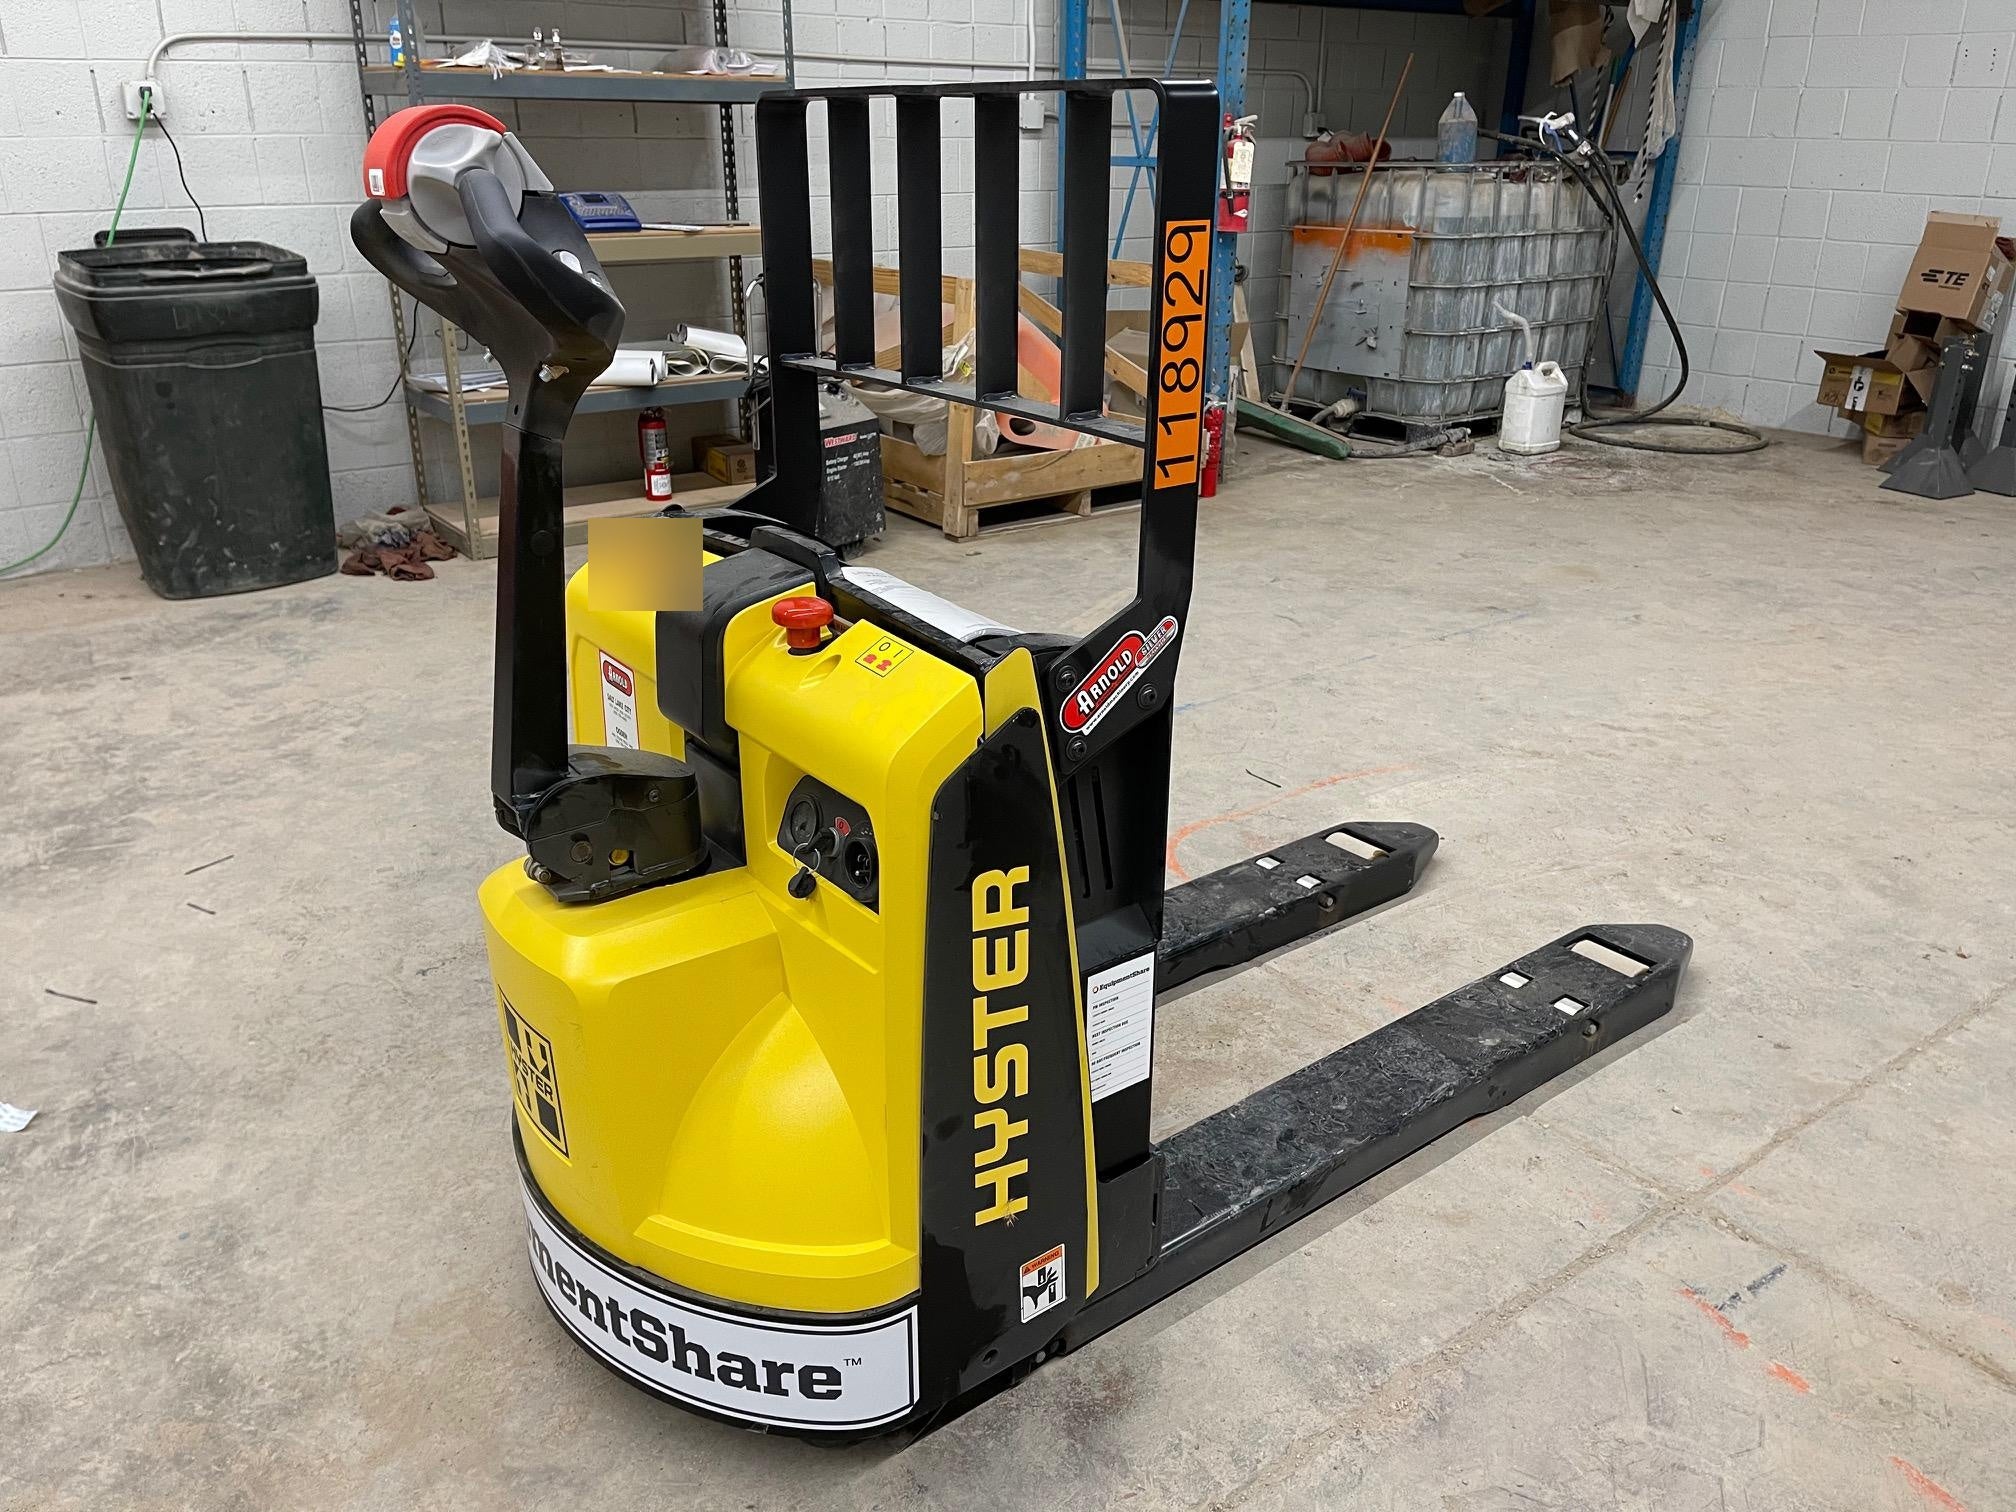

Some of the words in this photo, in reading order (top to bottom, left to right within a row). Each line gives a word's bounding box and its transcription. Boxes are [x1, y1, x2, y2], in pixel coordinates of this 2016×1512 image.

[1157, 223, 1207, 479] 118929
[1077, 650, 1133, 715] ARNOLD
[1099, 967, 1150, 991] EquipmentShare
[511, 1045, 554, 1101] HYSTER
[972, 865, 1029, 1226] HYSTER
[1032, 1250, 1060, 1269] WARNING
[528, 1219, 842, 1400] mentShare
